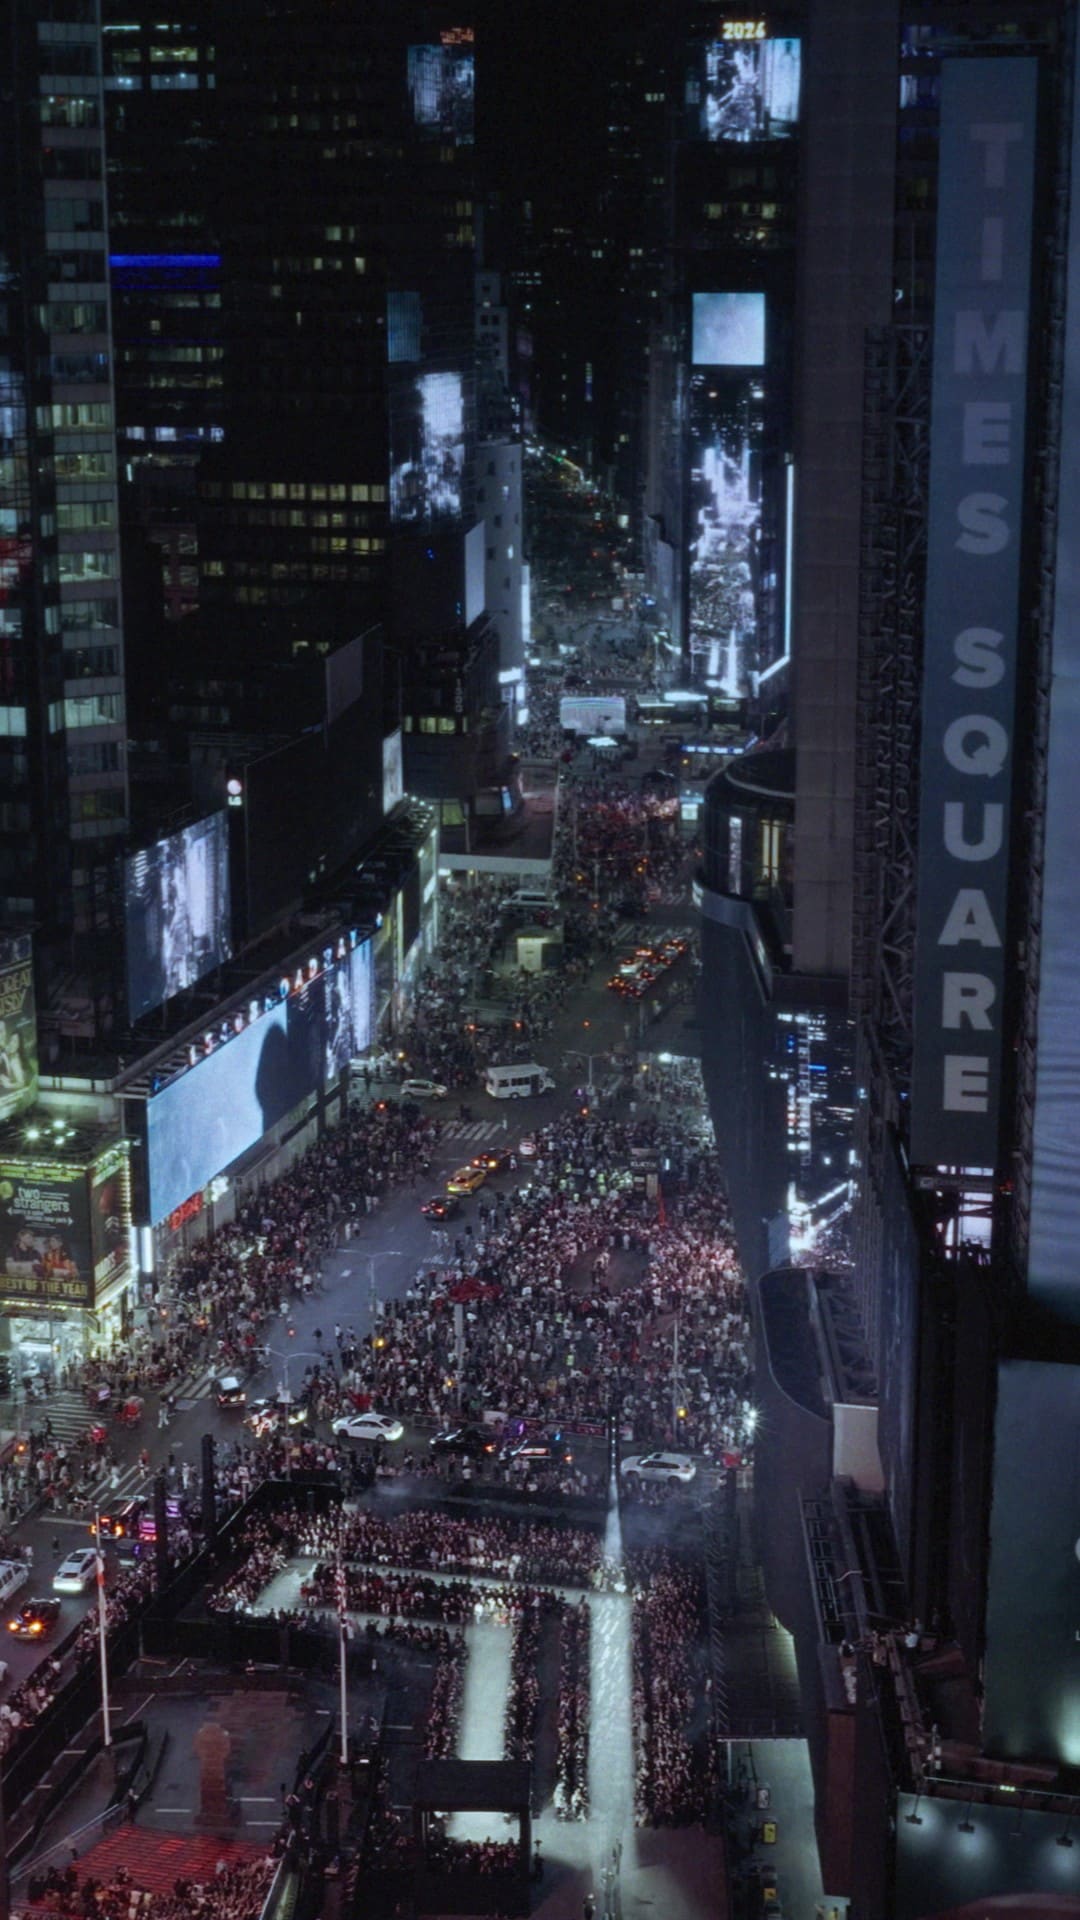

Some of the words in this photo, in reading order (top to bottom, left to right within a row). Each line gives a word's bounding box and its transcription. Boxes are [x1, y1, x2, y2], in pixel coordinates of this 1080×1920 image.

[954, 122, 1024, 556] TIMES
[879, 511, 898, 638] EAGLE
[874, 652, 894, 855] AMERICAN
[894, 571, 915, 817] OUTFITTERS
[938, 627, 1009, 1113] SQUARE
[14, 1197, 70, 1214] strangers
[18, 1187, 41, 1200] two
[25, 1279, 38, 1292] OF
[41, 1279, 60, 1294] THE
[62, 1282, 88, 1297] YEAR
